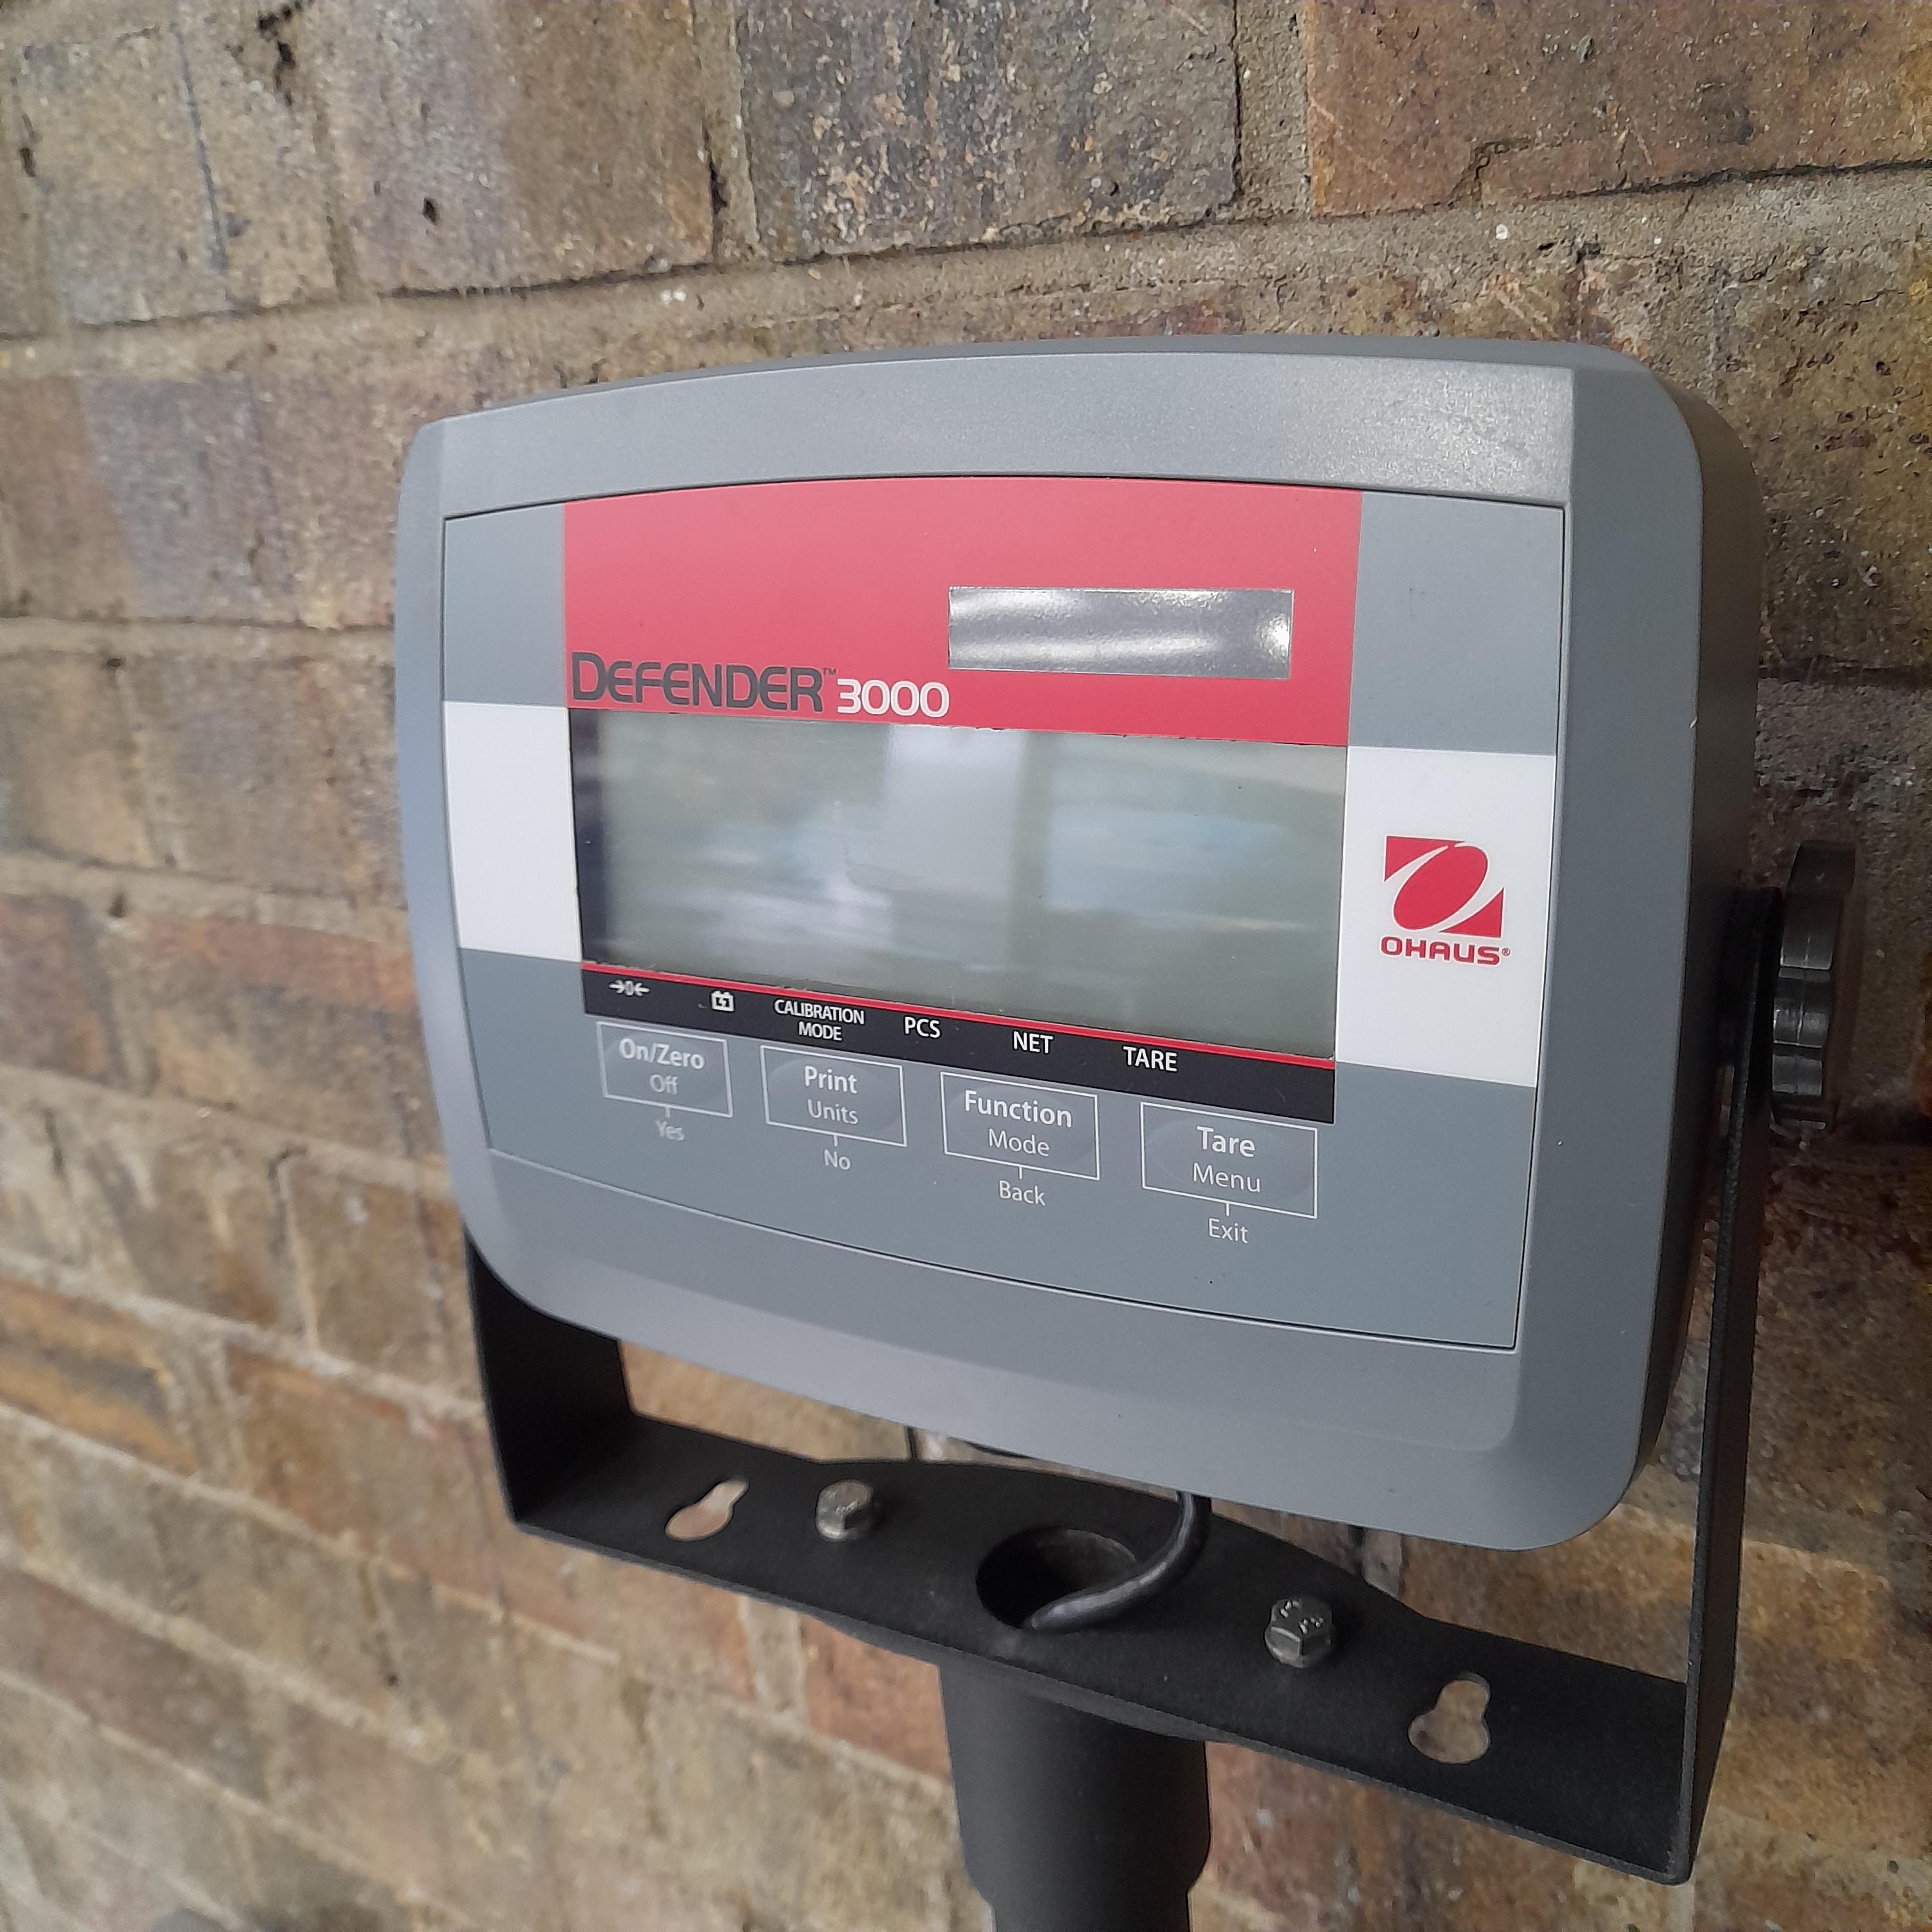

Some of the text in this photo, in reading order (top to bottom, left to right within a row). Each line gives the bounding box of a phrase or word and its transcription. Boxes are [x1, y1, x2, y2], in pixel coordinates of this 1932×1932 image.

[837, 678, 951, 718] 3000
[774, 998, 865, 1025] CALIBRATION
[798, 1021, 843, 1042] MODE
[903, 1016, 941, 1039] PCS
[619, 1038, 706, 1070] On/Zero
[1012, 1030, 1054, 1054] NET
[1123, 1045, 1178, 1073] TARE
[650, 1074, 679, 1094] Off
[803, 1065, 858, 1094] Print
[807, 1099, 859, 1125] Units
[963, 1089, 1073, 1129] Function
[655, 1120, 685, 1142] Yes
[987, 1127, 1051, 1157] Mode
[1196, 1125, 1256, 1158] Tare
[823, 1149, 851, 1171] No
[1191, 1162, 1262, 1194] Menu
[998, 1179, 1047, 1207] Back
[1208, 1218, 1249, 1244] Exit
